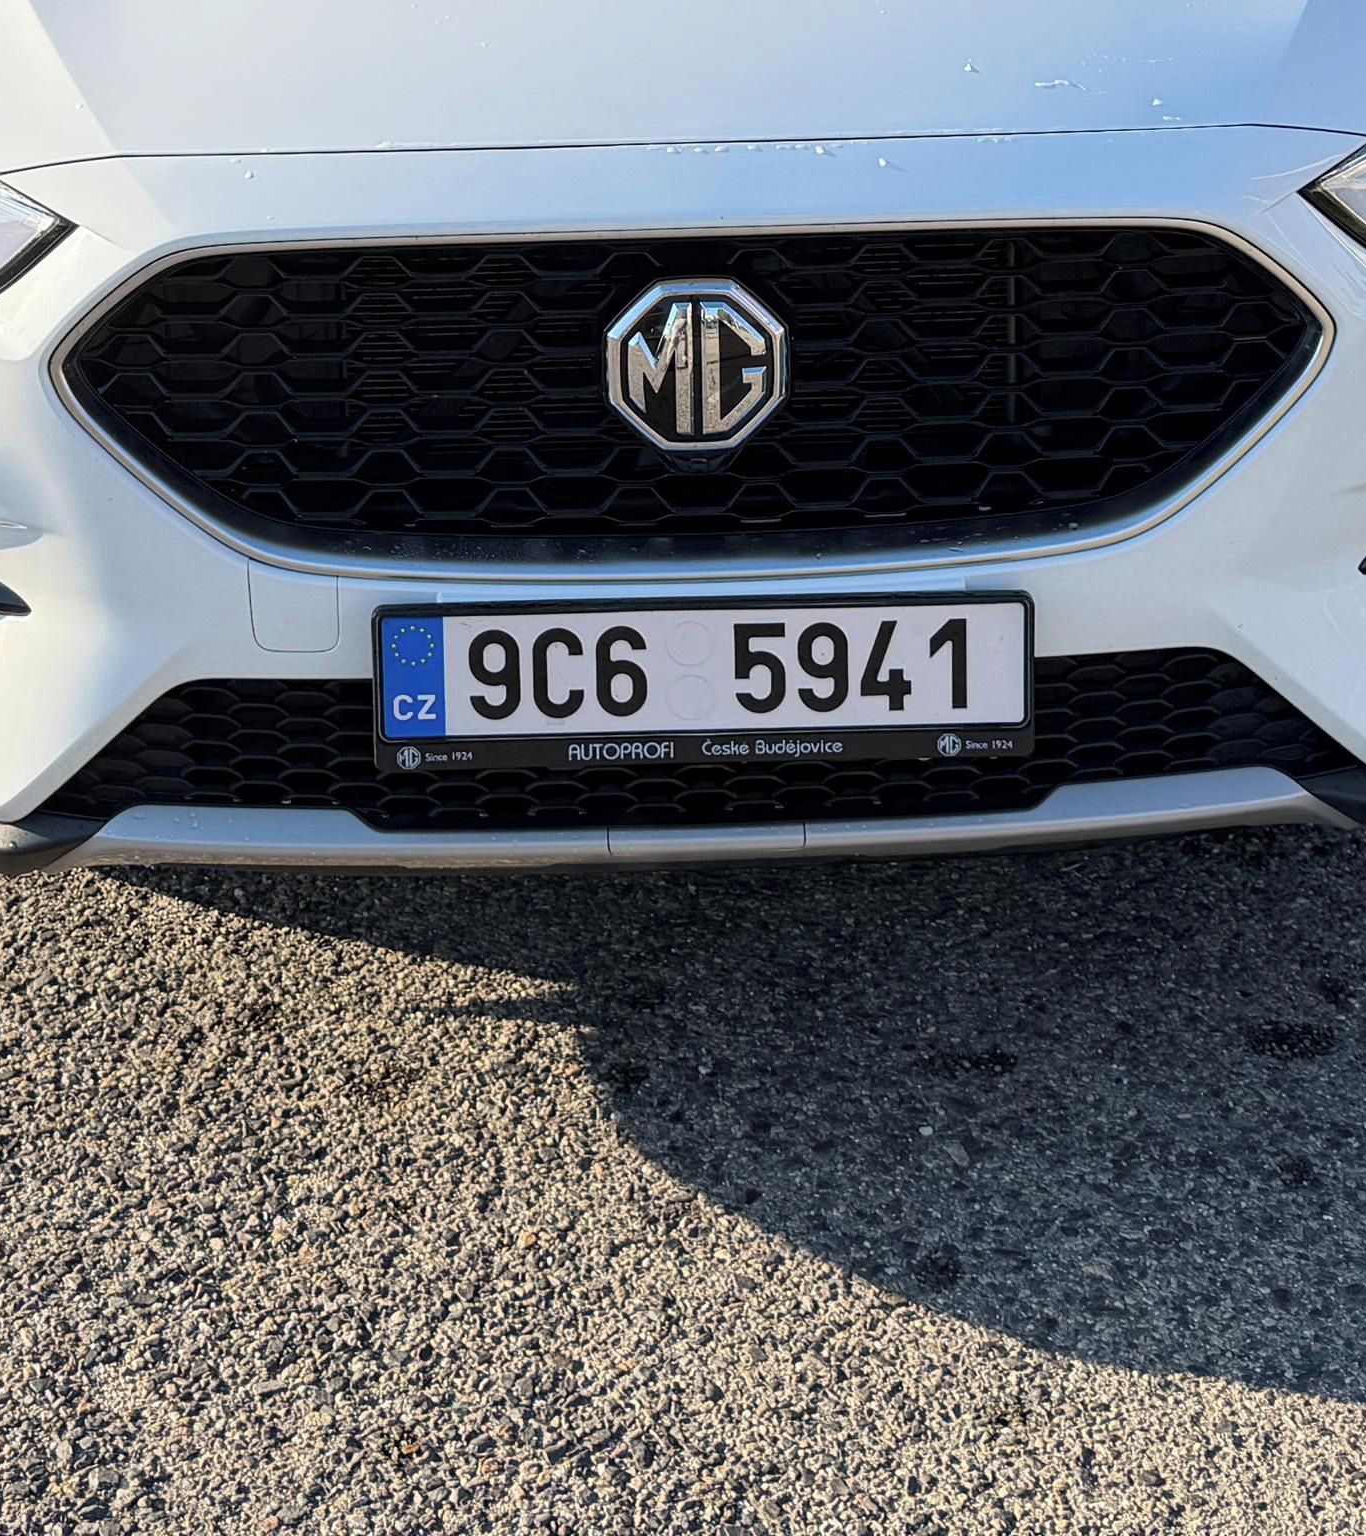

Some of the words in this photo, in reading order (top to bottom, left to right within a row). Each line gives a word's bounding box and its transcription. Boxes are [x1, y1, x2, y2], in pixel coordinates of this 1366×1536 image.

[625, 299, 770, 438] MG
[467, 624, 649, 721] 9C6
[733, 617, 969, 714] 5941
[393, 694, 438, 722] CZ
[397, 747, 421, 769] MG
[425, 751, 448, 762] Since
[451, 750, 473, 761] 1924
[568, 741, 675, 761] AUTOPROFI
[701, 737, 750, 756] České
[755, 738, 844, 758] Budějovice
[937, 733, 961, 757] MG
[965, 740, 989, 750] Since
[991, 739, 1013, 750] 1924
